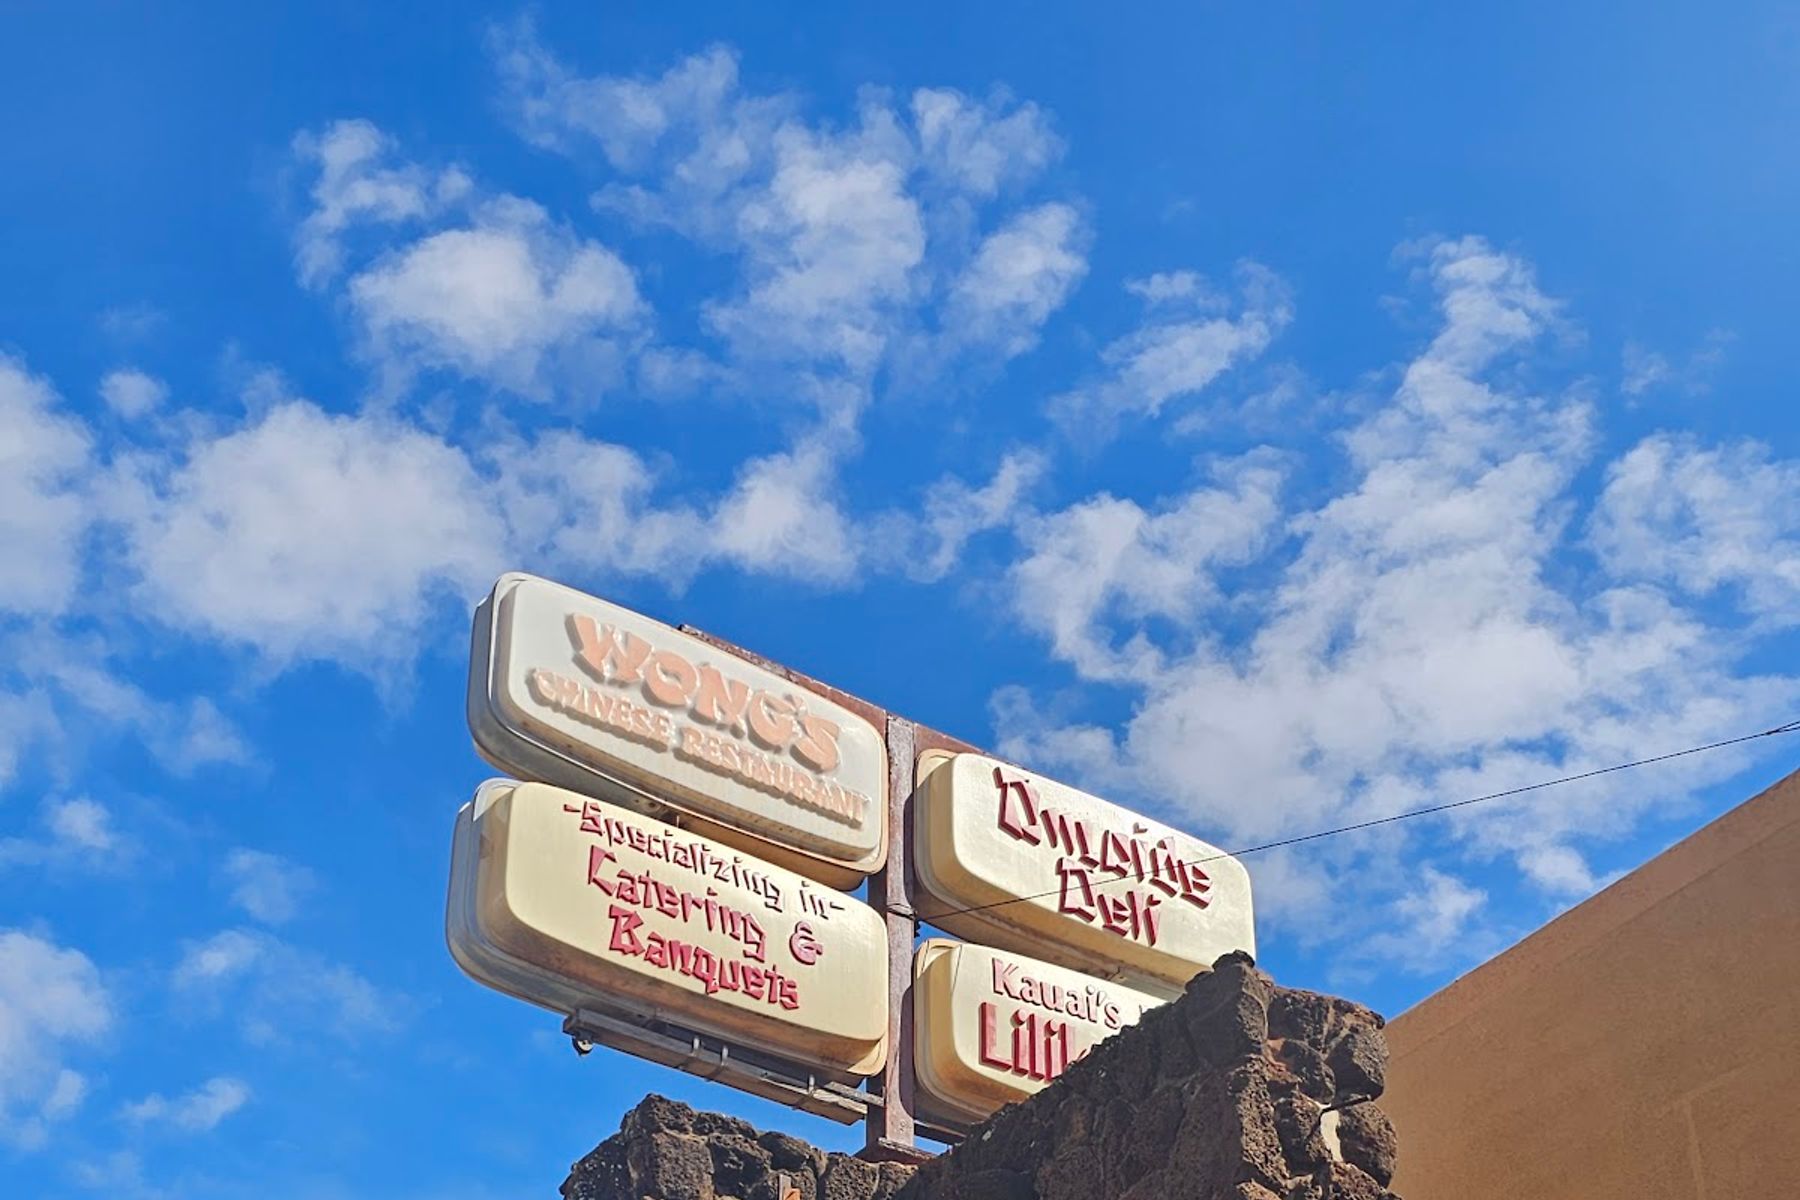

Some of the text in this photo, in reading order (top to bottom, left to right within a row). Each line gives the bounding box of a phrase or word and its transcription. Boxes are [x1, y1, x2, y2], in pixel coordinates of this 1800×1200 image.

[530, 668, 870, 829] CHINESE RESTAURANT
[566, 613, 840, 772] WONG'S
[587, 845, 824, 965] Catering &
[608, 905, 800, 1010] Banquets
[1055, 857, 1162, 947] Deli
[992, 957, 1122, 1030] Kauai's
